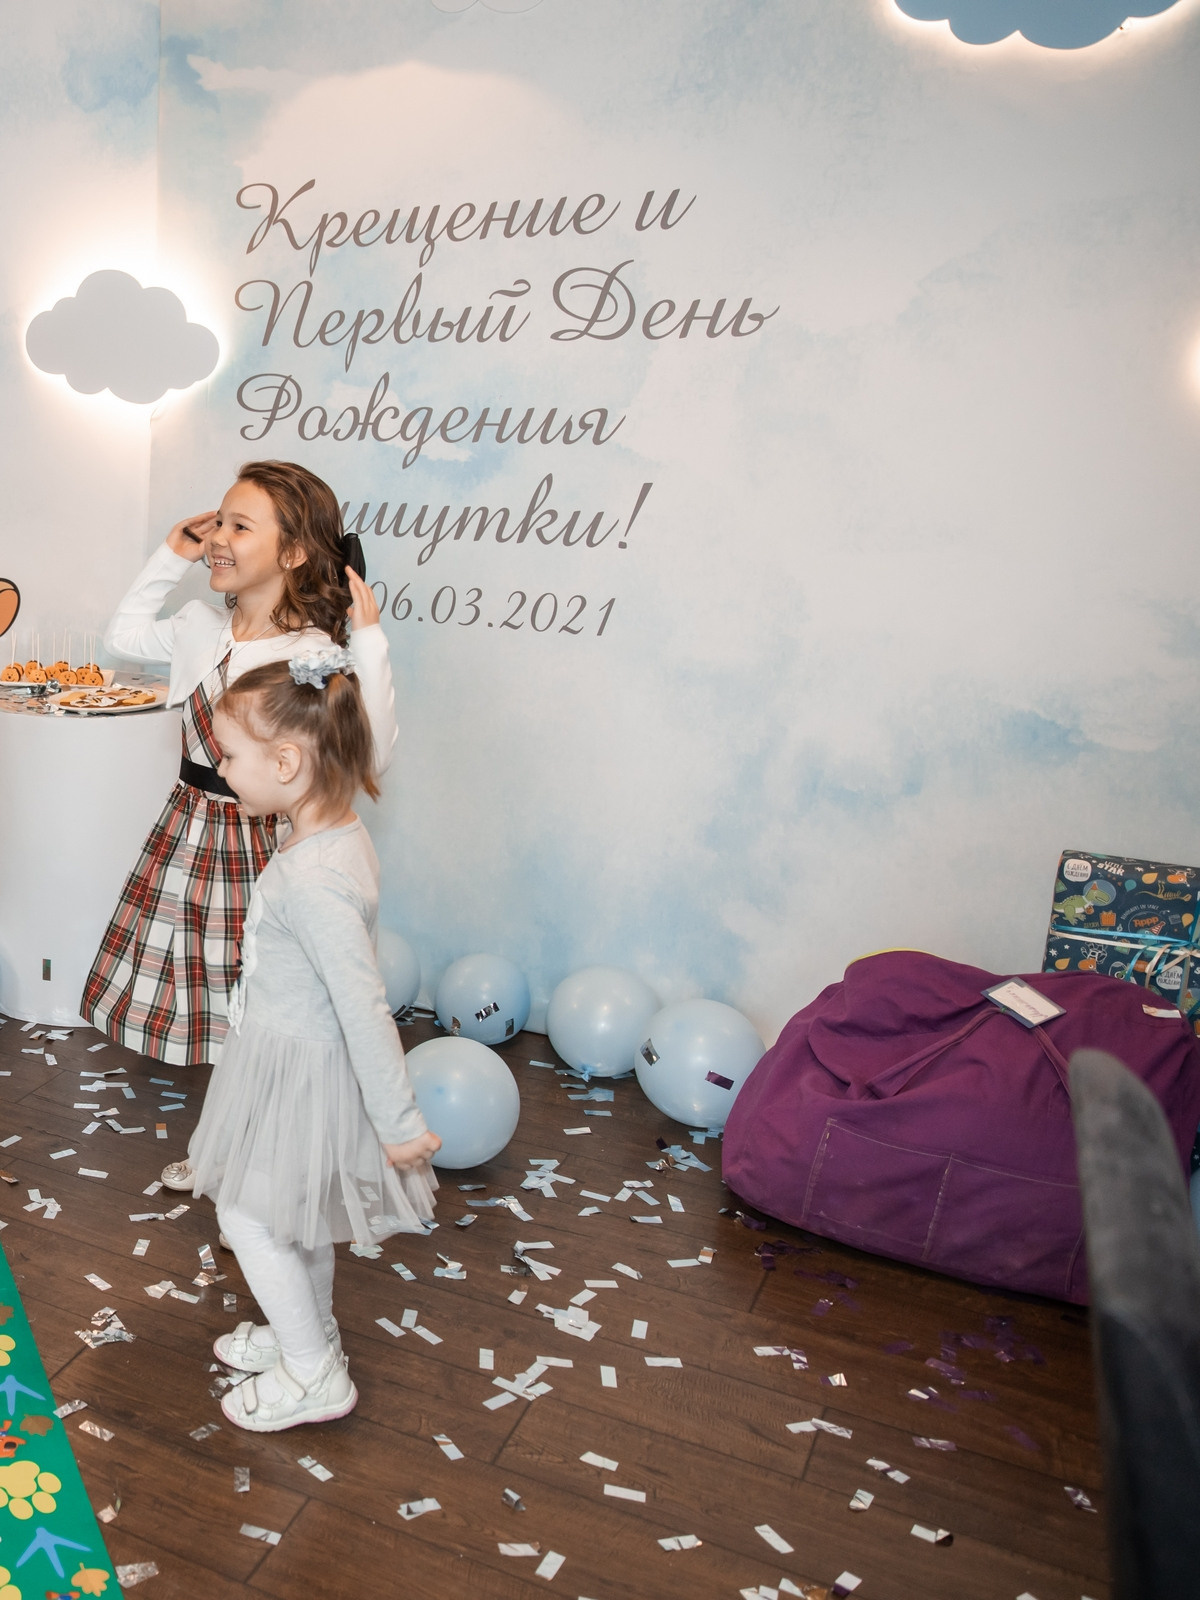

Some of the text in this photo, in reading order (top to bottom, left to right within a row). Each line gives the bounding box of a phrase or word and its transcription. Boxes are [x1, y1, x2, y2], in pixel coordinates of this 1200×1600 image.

[236, 178, 698, 277] Крещение и
[234, 259, 780, 373] Первый День
[236, 371, 627, 470] Рождения
[340, 472, 654, 567] шутки!
[370, 580, 617, 637] 06.03.2021
[1097, 862, 1125, 877] STAR
